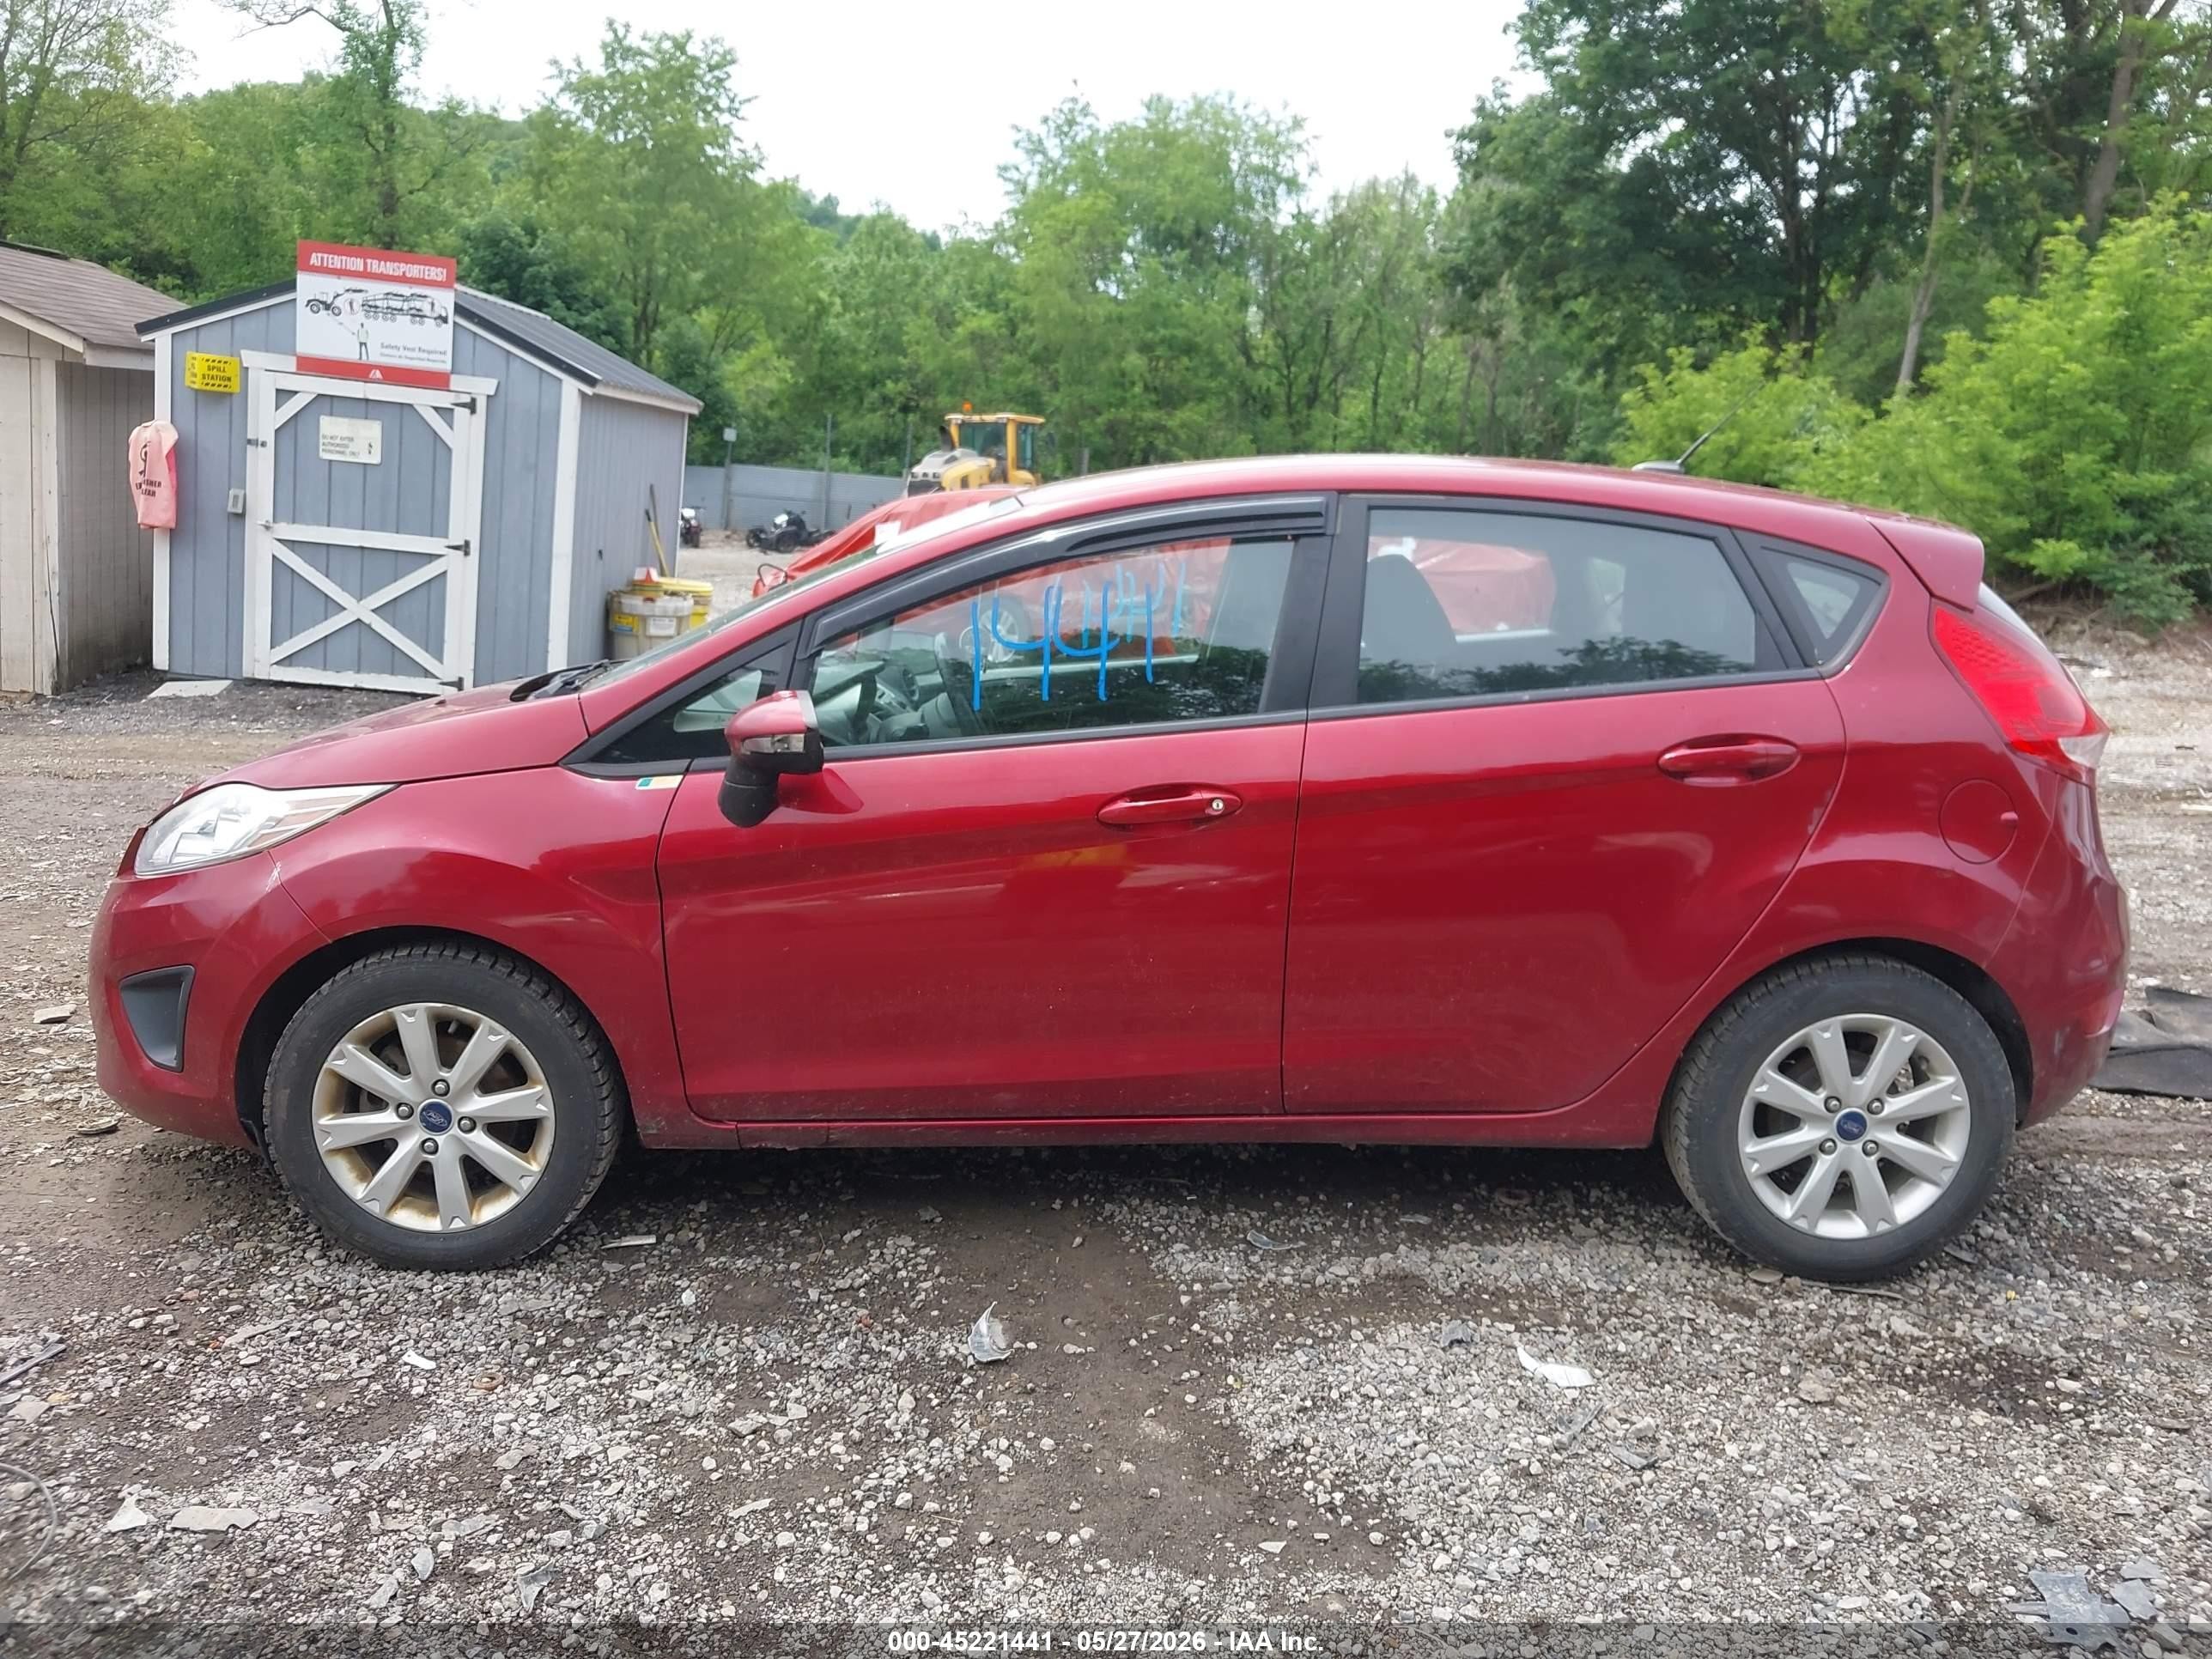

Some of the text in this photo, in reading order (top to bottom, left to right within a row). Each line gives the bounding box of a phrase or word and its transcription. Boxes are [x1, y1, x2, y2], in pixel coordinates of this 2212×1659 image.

[309, 252, 447, 282] ATTENTION TRANSPORTERS!
[380, 342, 401, 351] Safety
[201, 373, 232, 382] STATION
[970, 579, 1155, 712] 1441
